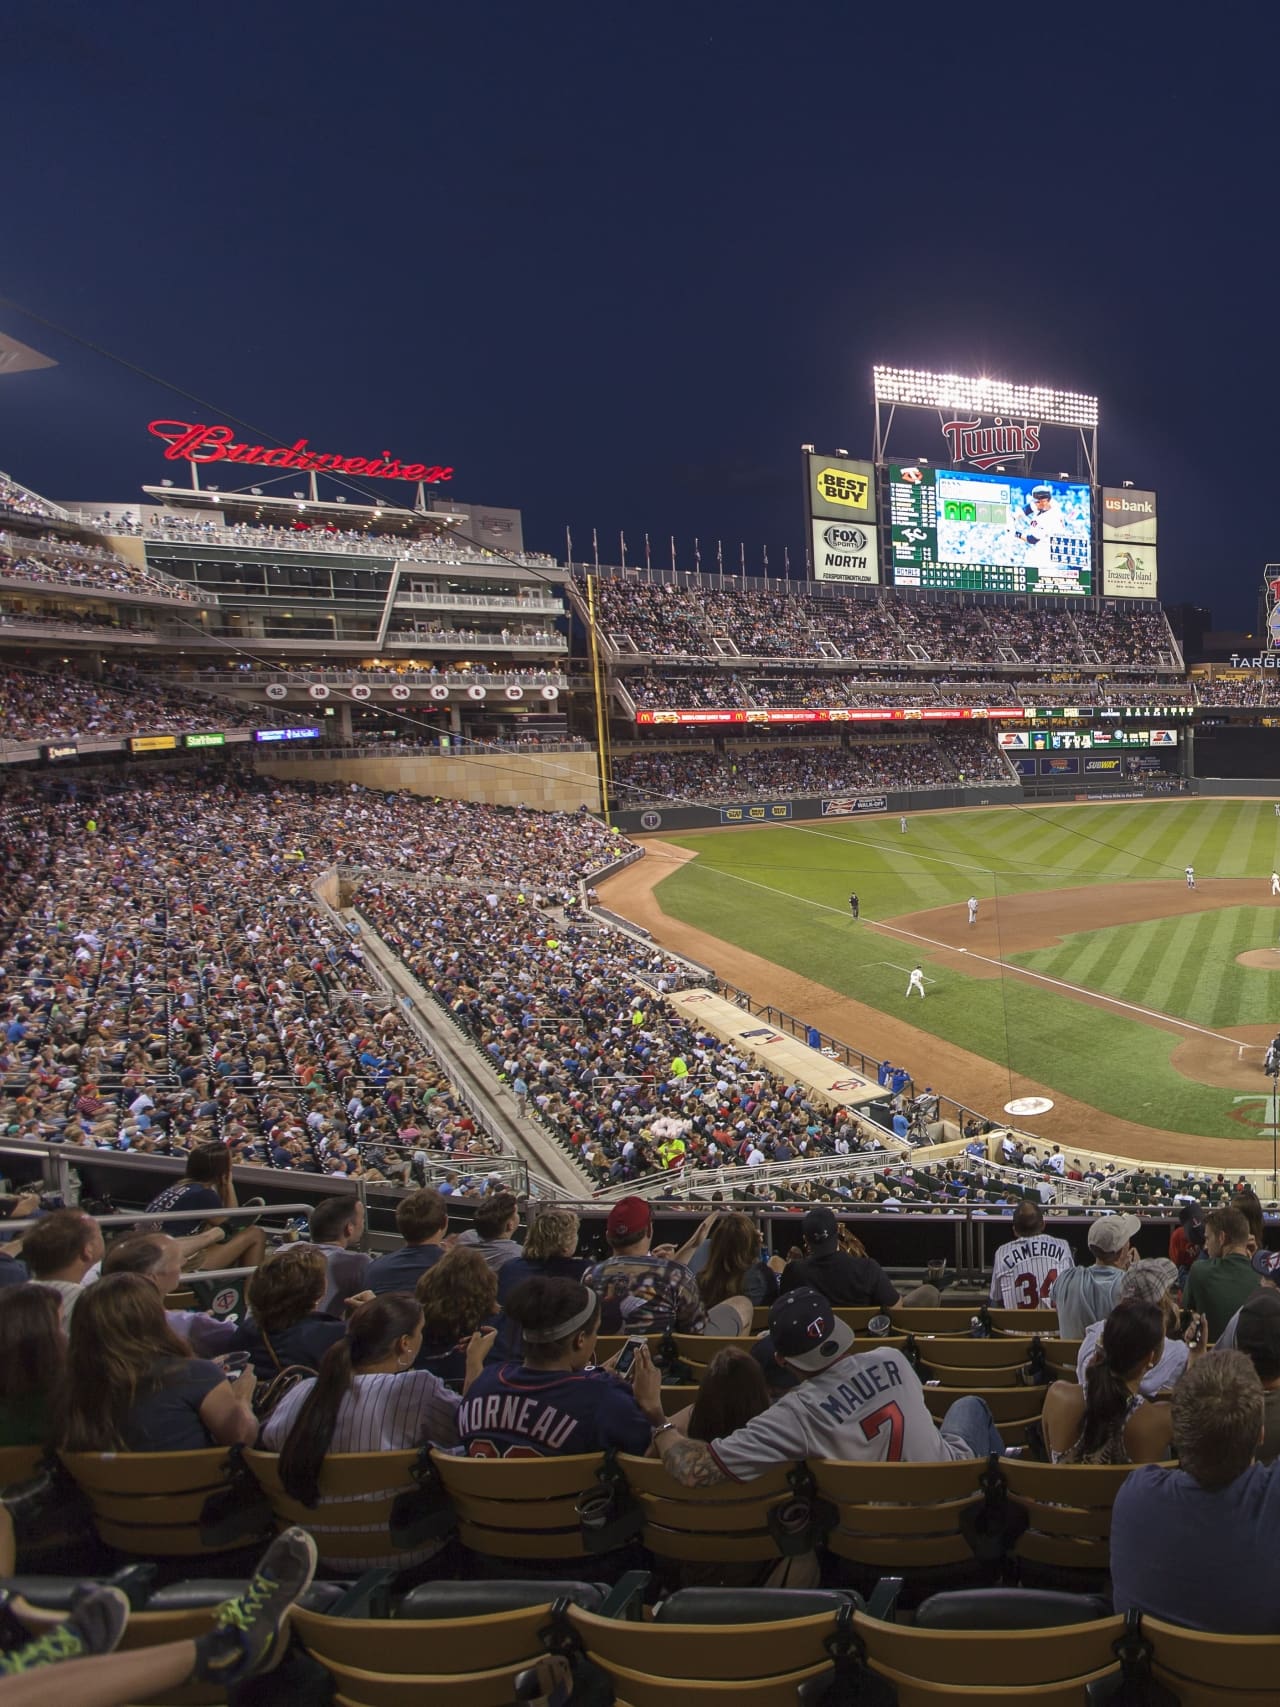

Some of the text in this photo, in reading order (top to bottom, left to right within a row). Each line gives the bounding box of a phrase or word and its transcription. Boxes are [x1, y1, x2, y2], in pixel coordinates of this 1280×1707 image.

[148, 420, 454, 481] Budweiser
[942, 417, 1040, 463] Twins
[824, 473, 867, 492] BEST
[825, 486, 862, 502] BUY
[832, 528, 857, 542] FOX
[825, 553, 867, 568] NORTH
[1106, 569, 1152, 582] Treasure Island
[271, 688, 283, 696] 42
[396, 688, 407, 696] 34
[1086, 760, 1119, 769] SUBWAY
[1003, 1241, 1065, 1269] CAMERON
[1015, 1268, 1057, 1309] 34
[820, 1360, 902, 1425] MAUER
[459, 1394, 578, 1449] MORNEAU
[859, 1399, 905, 1462] 7
